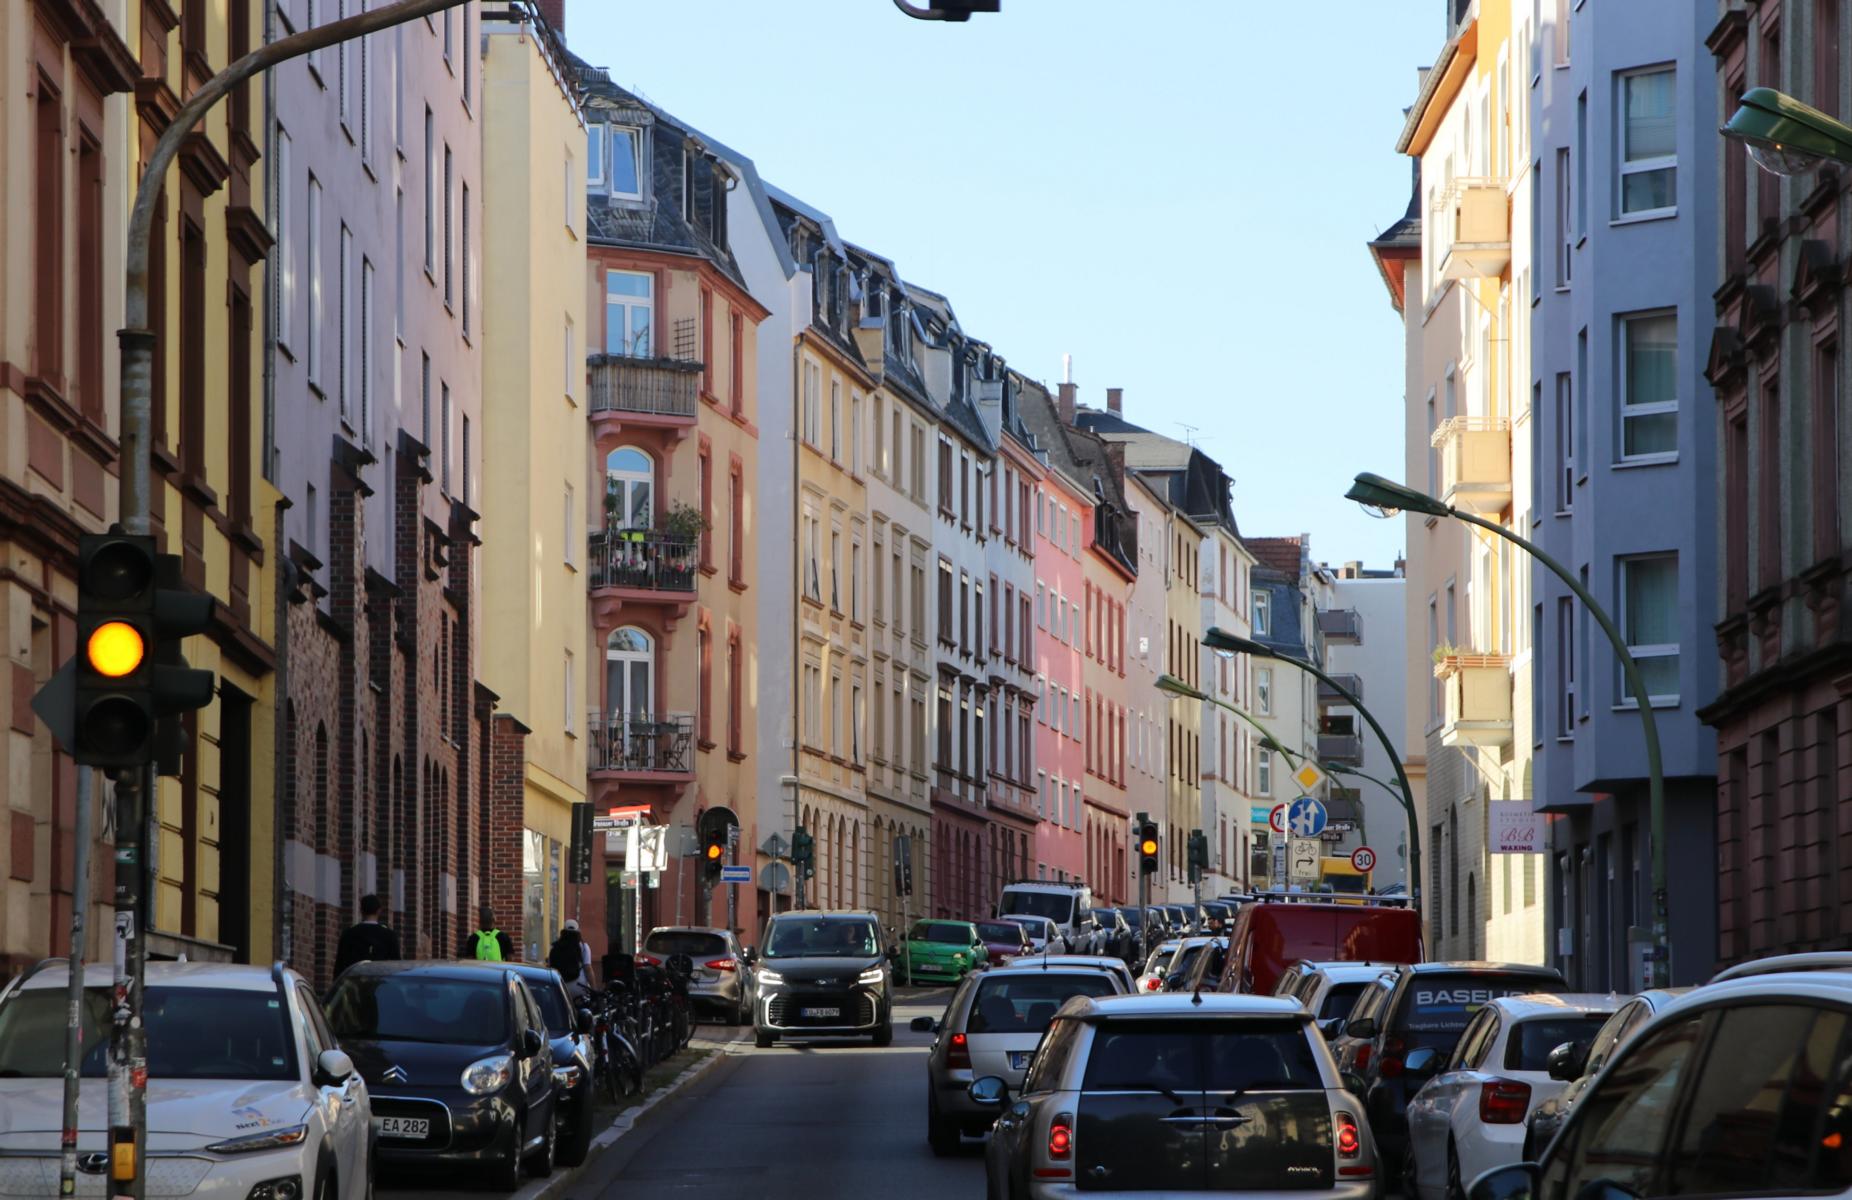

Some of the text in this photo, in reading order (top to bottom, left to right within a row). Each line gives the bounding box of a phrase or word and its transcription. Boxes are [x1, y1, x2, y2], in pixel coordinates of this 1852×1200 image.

[1356, 853, 1371, 866] 30
[1408, 1023, 1439, 1034] Tragbare
[402, 1119, 428, 1134] 282
